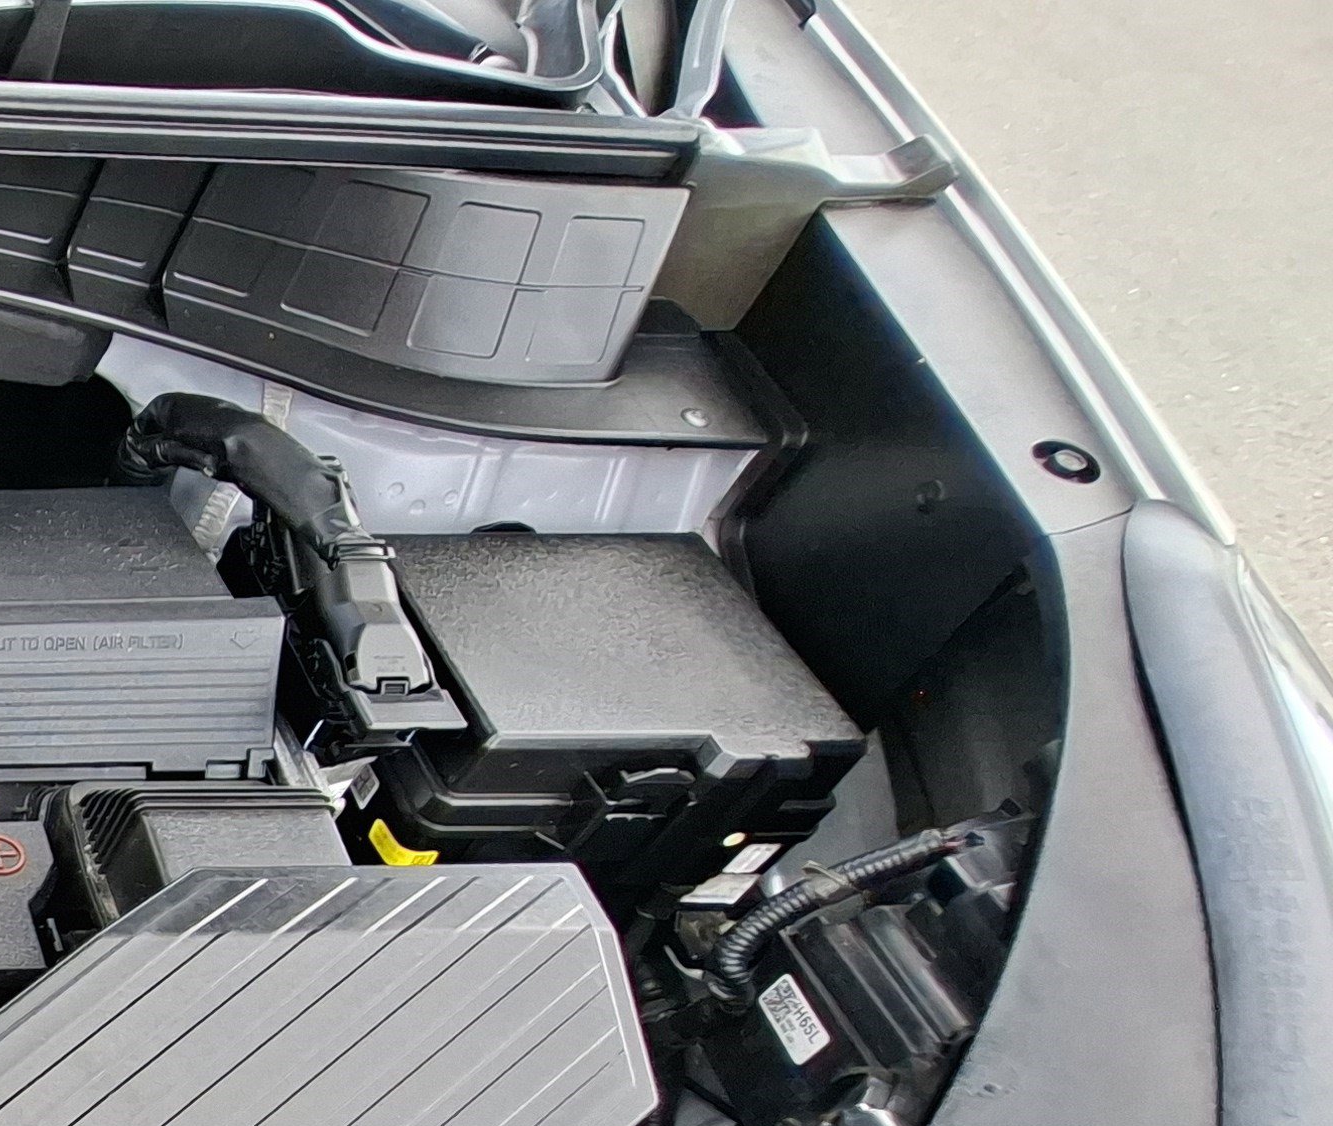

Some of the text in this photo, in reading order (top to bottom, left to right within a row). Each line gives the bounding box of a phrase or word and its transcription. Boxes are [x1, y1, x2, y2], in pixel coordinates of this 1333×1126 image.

[21, 637, 39, 650] TO
[44, 636, 86, 650] OPEN
[93, 634, 124, 650] (AIR
[129, 633, 184, 650] FILTER)
[793, 1006, 820, 1044] H65L
